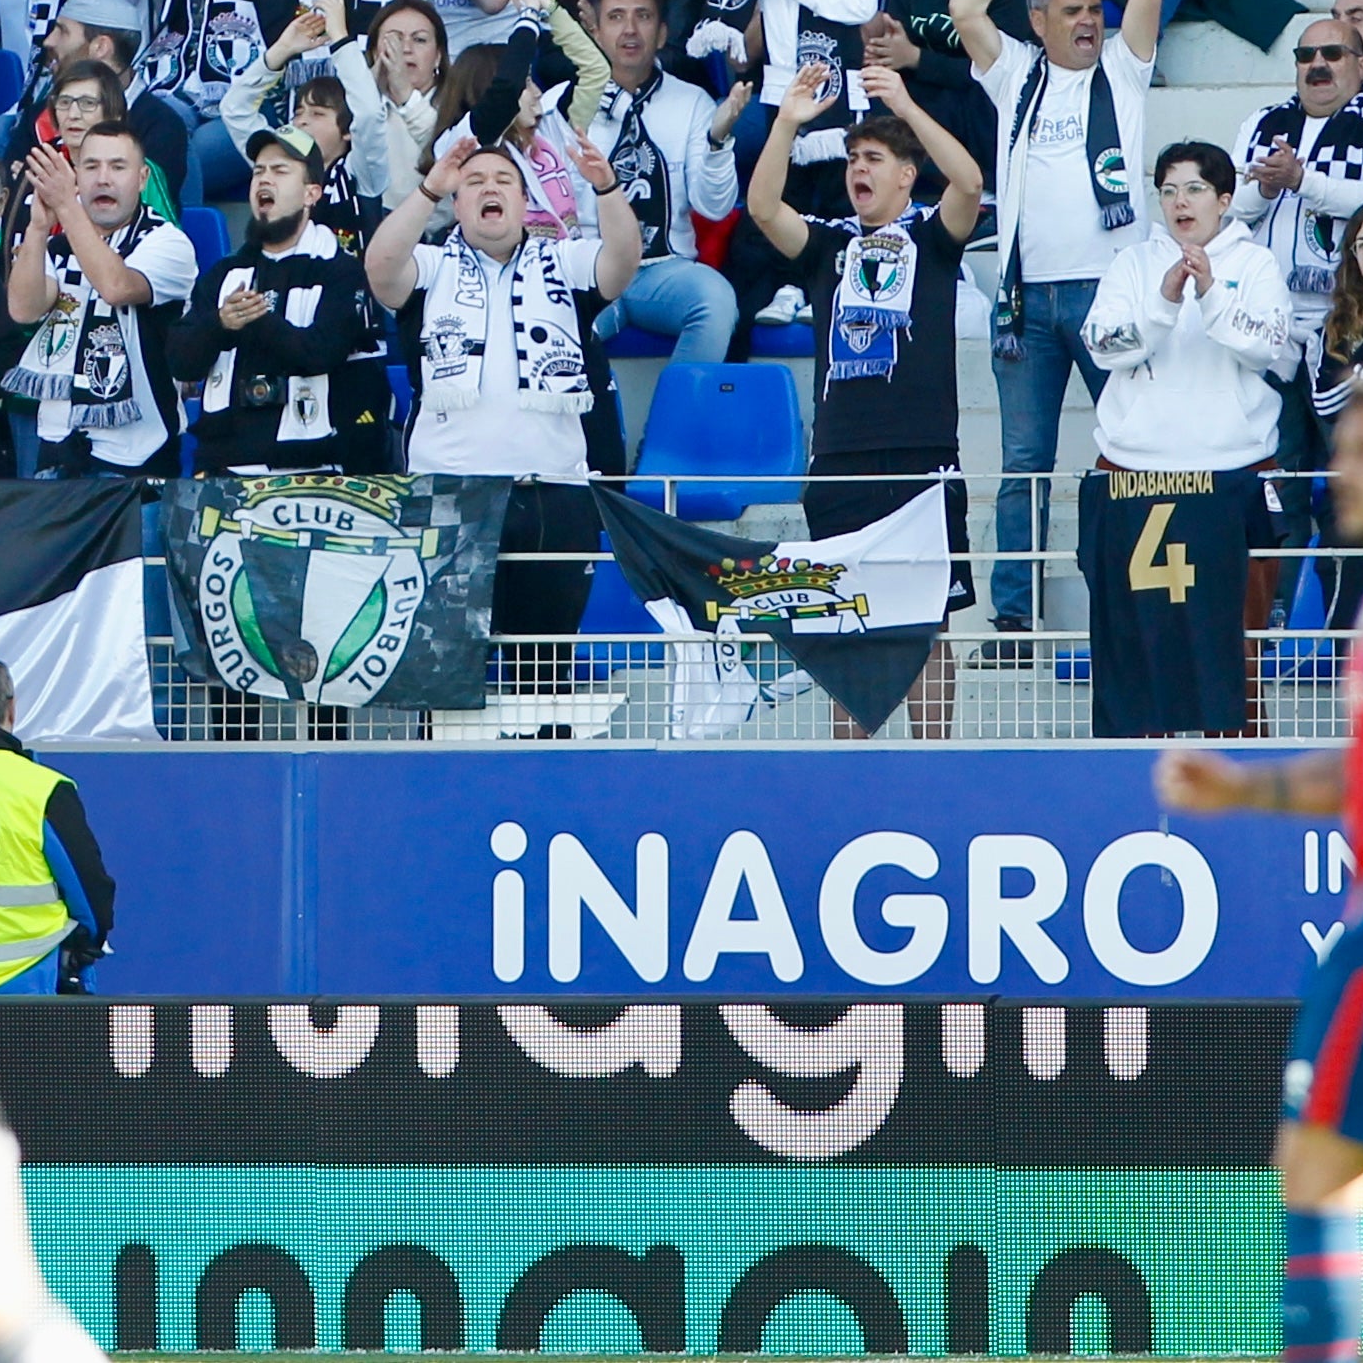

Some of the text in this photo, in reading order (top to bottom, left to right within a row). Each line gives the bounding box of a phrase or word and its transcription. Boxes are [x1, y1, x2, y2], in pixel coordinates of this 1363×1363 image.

[272, 502, 355, 531] CLUB
[1127, 502, 1196, 604] 4
[205, 550, 260, 691] BURGOS
[347, 575, 419, 692] FUTBOL
[753, 590, 811, 611] CLUB
[489, 820, 1220, 986] iNAGRO
